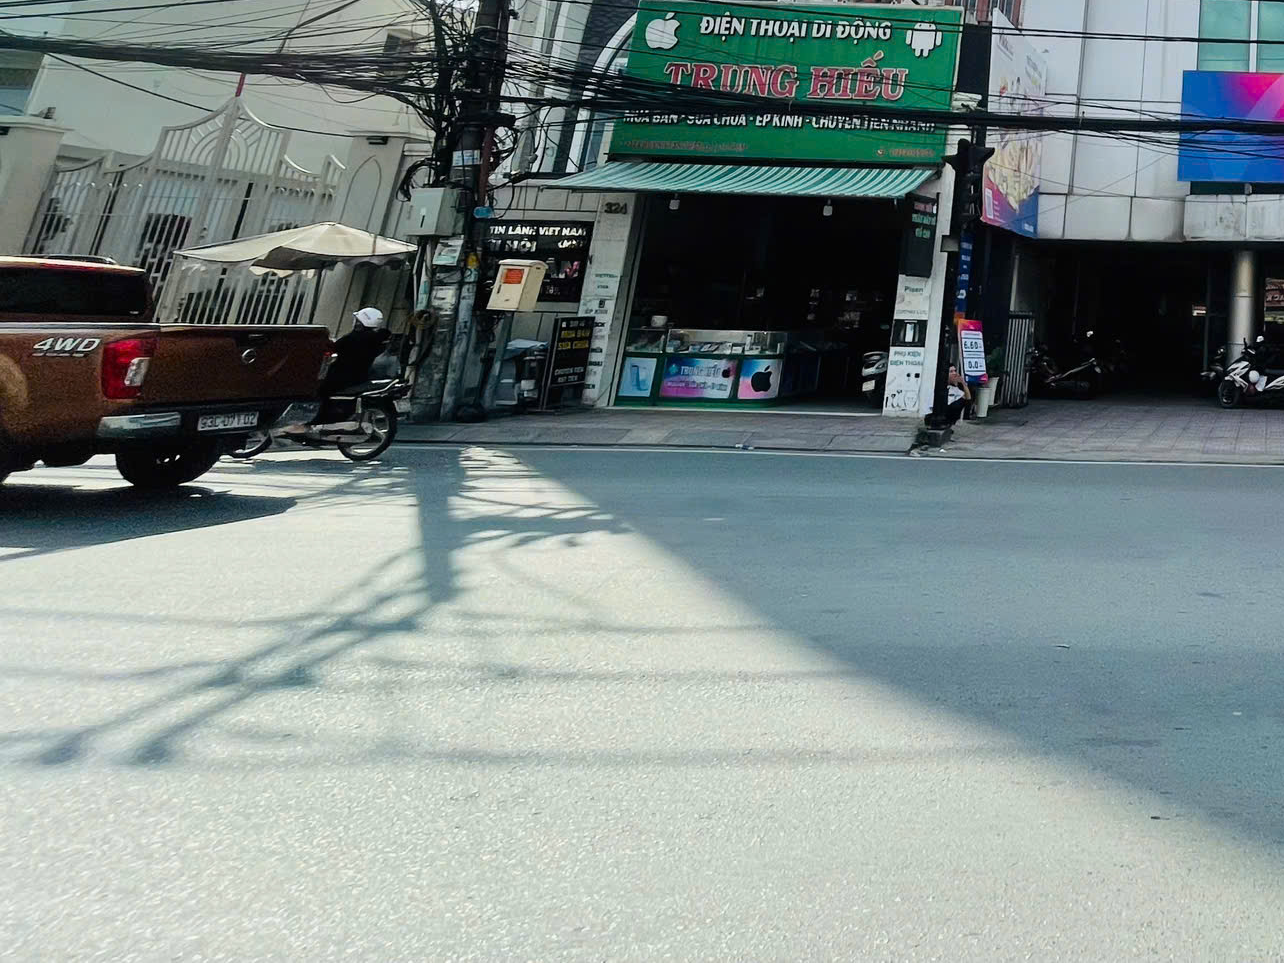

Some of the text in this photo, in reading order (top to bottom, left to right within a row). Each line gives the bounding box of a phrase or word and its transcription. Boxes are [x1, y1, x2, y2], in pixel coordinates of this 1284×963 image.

[700, 12, 892, 44] ĐIỆN THOẠI DI ĐỘNG
[664, 49, 909, 101] TRUNG HIẾU
[32, 337, 101, 352] 4WD
